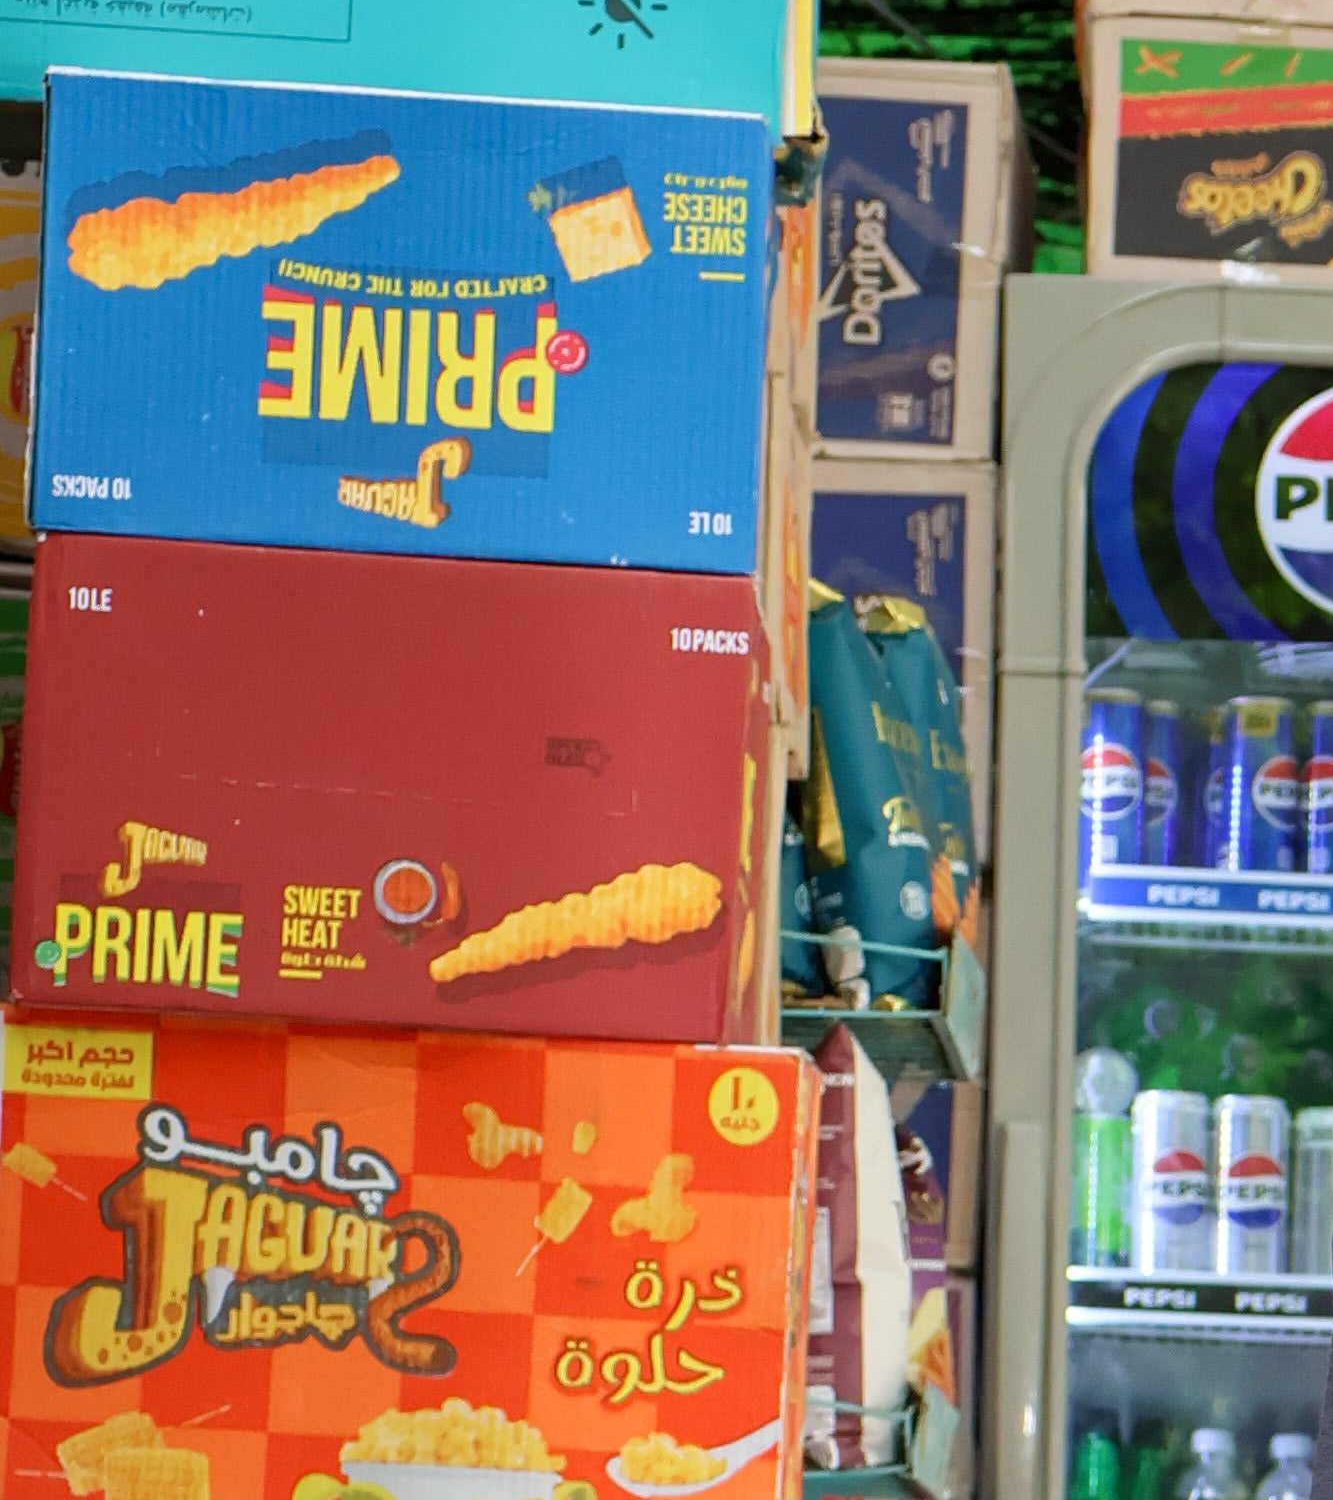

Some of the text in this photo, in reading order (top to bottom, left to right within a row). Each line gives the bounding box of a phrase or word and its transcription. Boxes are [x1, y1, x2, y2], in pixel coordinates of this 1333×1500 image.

[664, 192, 747, 223] CHEESE
[1177, 151, 1327, 235] Cheetos
[671, 227, 746, 256] SWEET
[365, 274, 404, 297] THE
[410, 275, 449, 298] FOR
[456, 272, 548, 298] CRAFTED
[842, 198, 890, 347] Doritos
[258, 286, 557, 432] PRIME
[336, 436, 471, 529] JAGUAR
[103, 820, 208, 898] JAGUAR
[283, 885, 362, 918] SWEET
[1148, 885, 1331, 913] PEPSI PEPSI
[281, 918, 342, 949] HEAT
[53, 903, 244, 998] PRIME
[78, 1047, 135, 1070] حجم
[91, 1072, 134, 1091] لفترة
[48, 1164, 402, 1384] JAGUAR
[624, 1258, 744, 1332] ذرة
[1123, 1286, 1308, 1314] PEPSI PEPSI
[555, 1338, 726, 1405] حلوة
